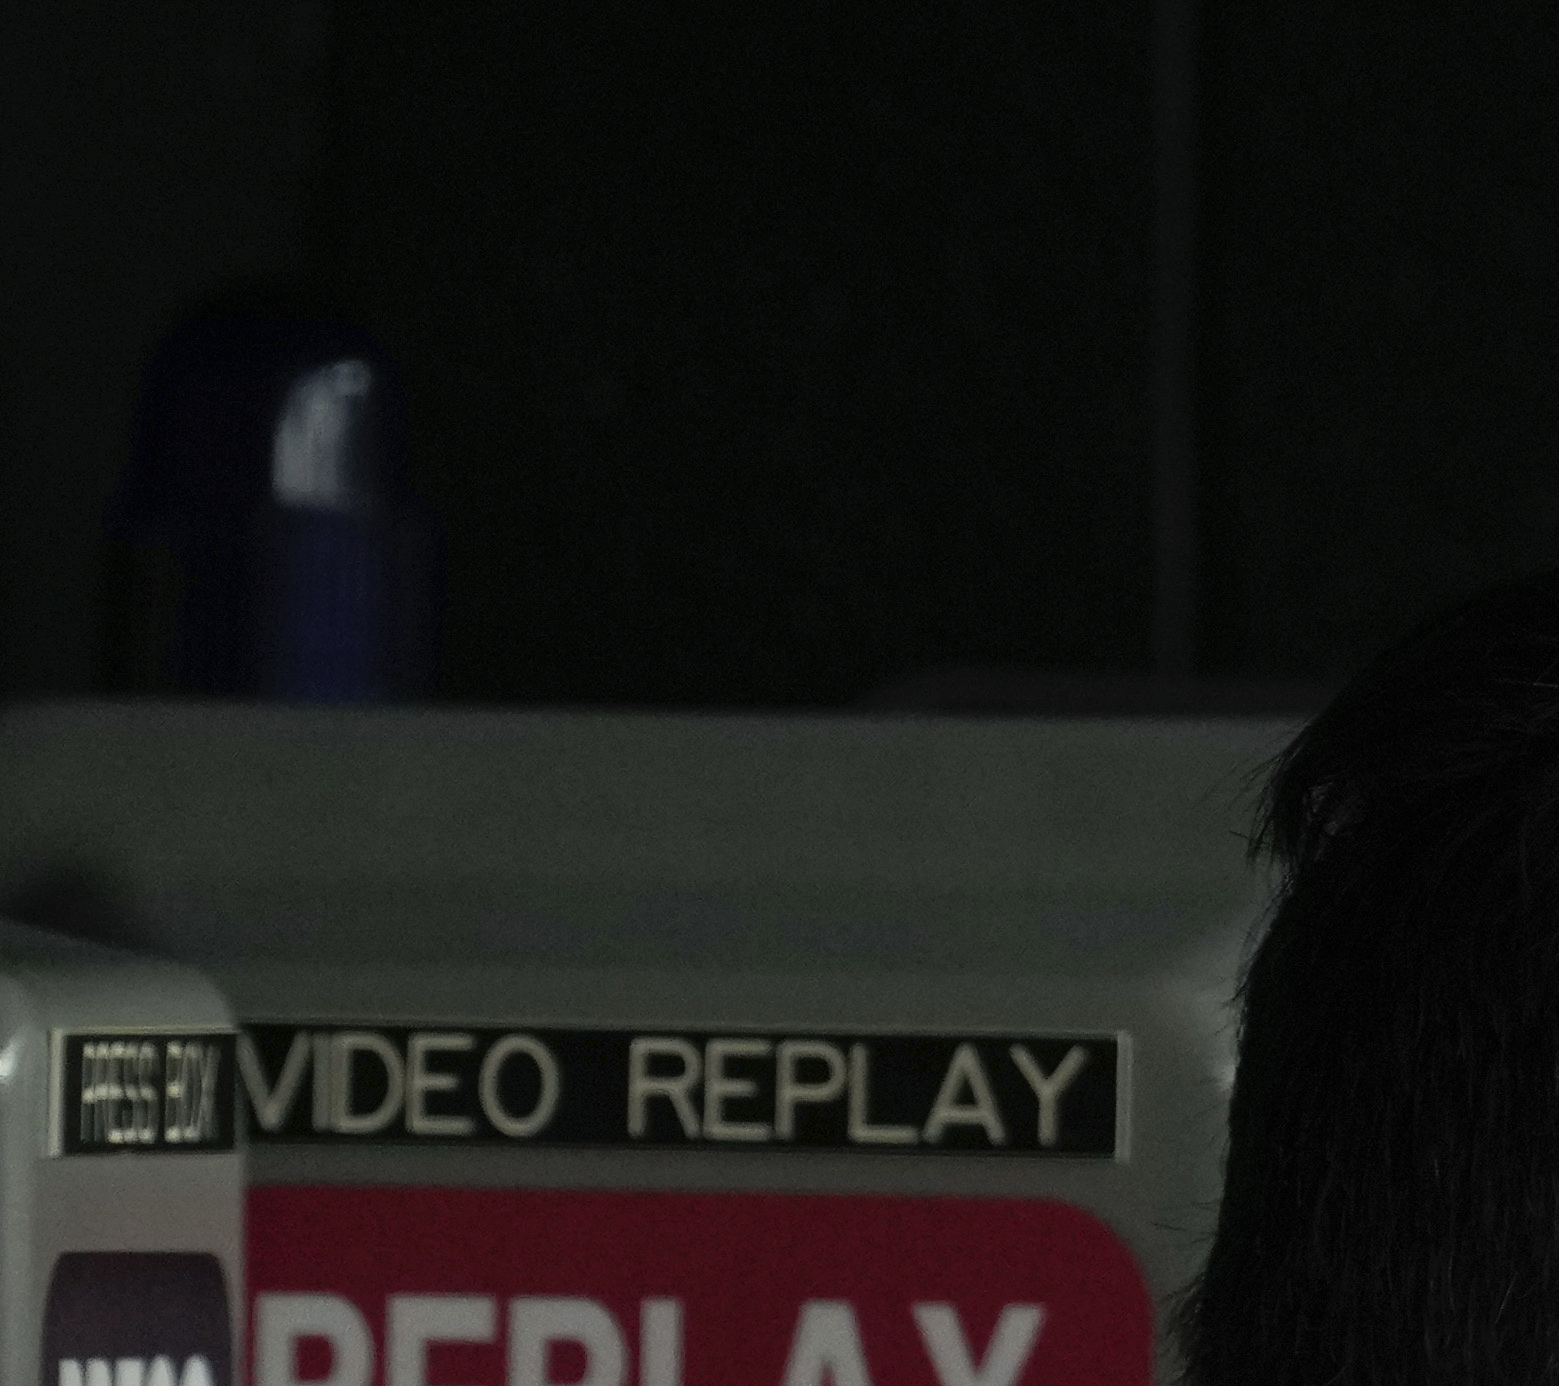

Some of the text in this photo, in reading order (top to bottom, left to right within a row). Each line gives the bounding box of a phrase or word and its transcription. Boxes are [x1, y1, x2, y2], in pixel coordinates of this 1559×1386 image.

[80, 1040, 221, 1144] PRESS BOX
[241, 1031, 1090, 1148] VIDEO REPLAY
